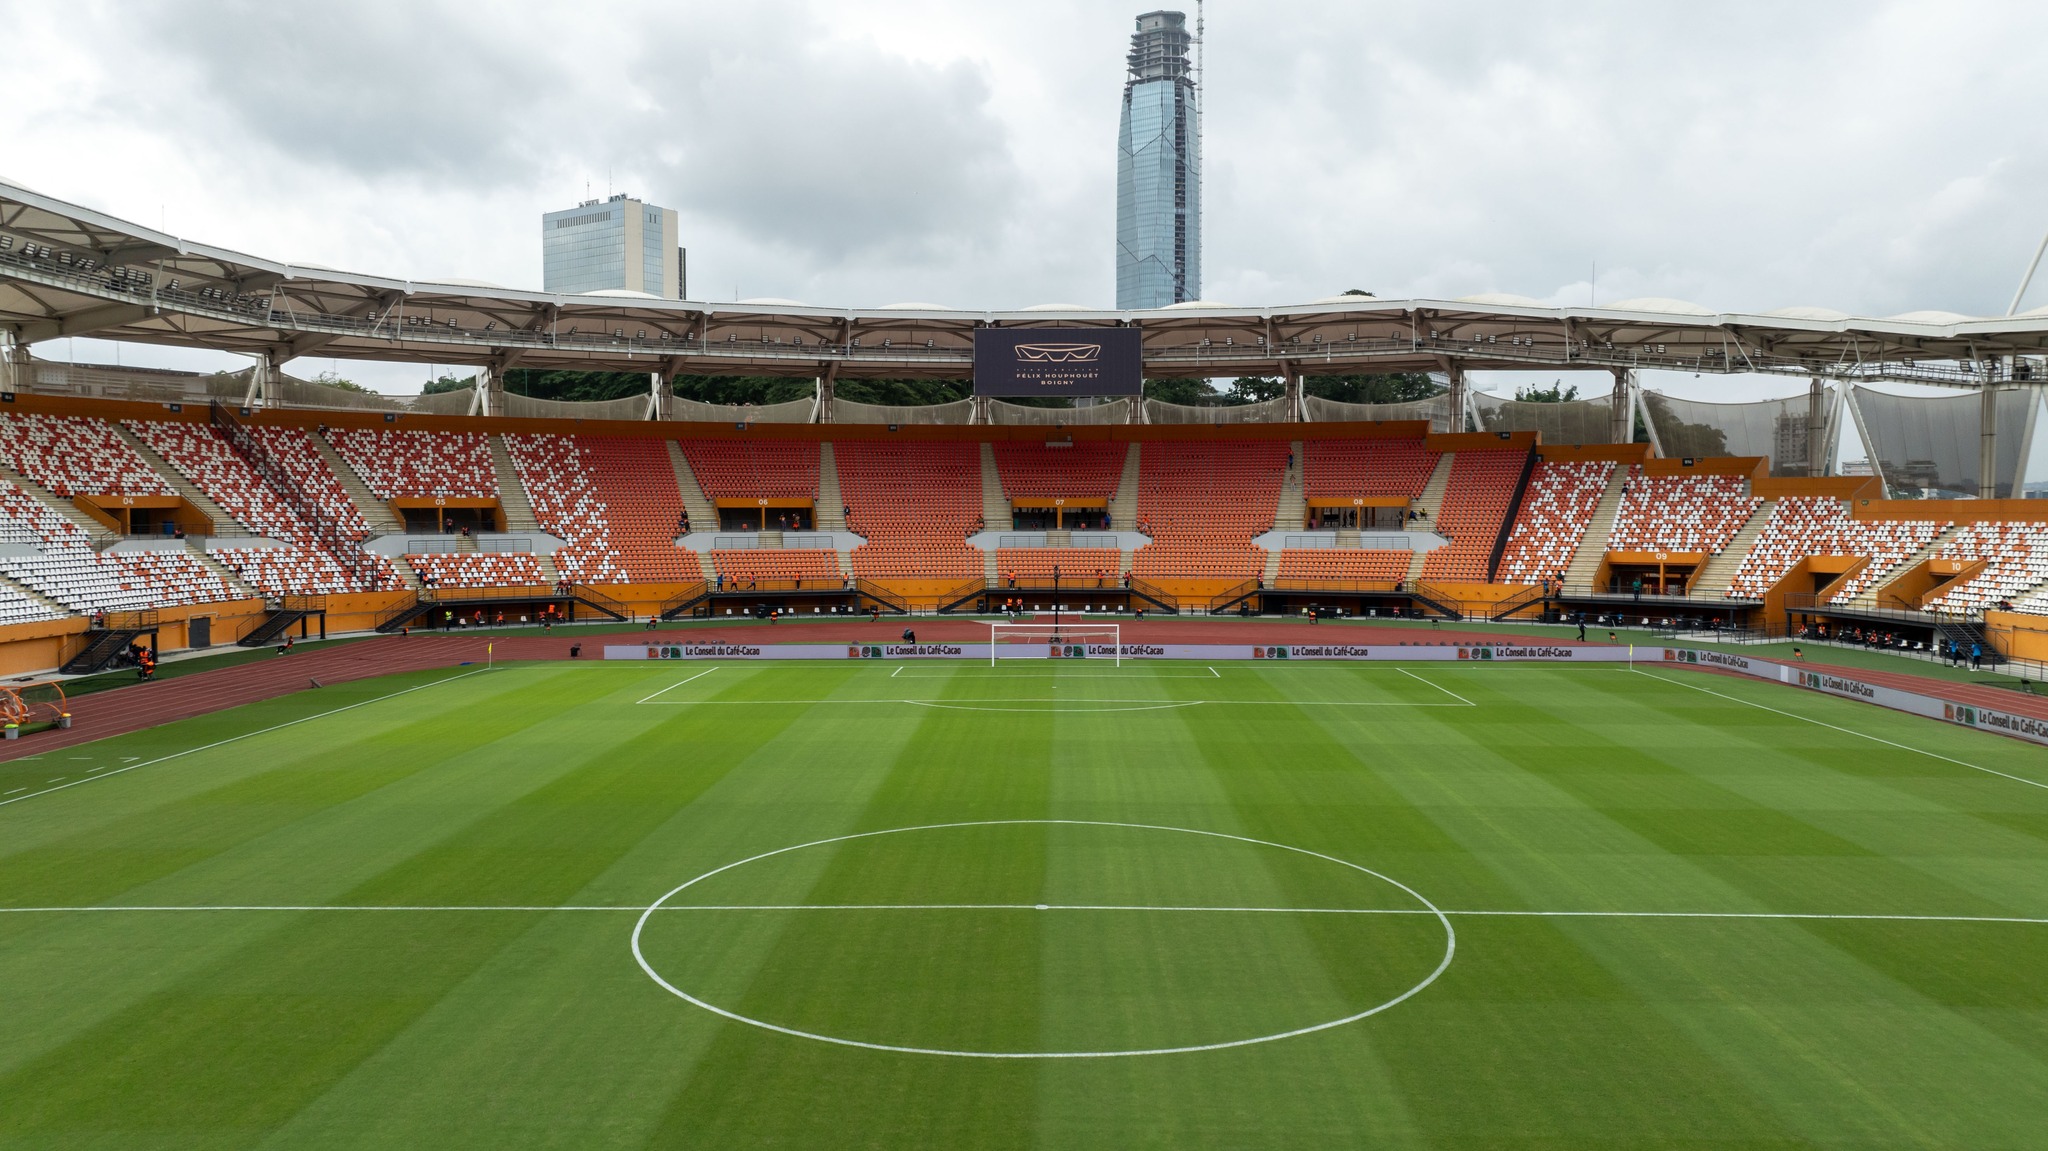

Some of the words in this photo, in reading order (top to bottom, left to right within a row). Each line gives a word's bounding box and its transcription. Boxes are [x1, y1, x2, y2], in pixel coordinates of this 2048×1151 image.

[1952, 562, 1961, 570] 10
[686, 646, 694, 656] Le
[694, 646, 716, 656] Conseil
[718, 646, 725, 656] du
[726, 645, 760, 656] Café-Cacao
[886, 646, 894, 655] Le
[896, 646, 917, 655] Conseil
[918, 646, 926, 655] du
[927, 644, 962, 655] Café-Cacao
[1088, 645, 1096, 654] Le
[1098, 645, 1118, 654] Consei
[1120, 646, 1128, 654] du
[1130, 644, 1164, 655] Café-Cacao
[1292, 646, 1300, 656] Le
[1301, 646, 1324, 656] Conseil
[1324, 646, 1332, 656] du
[1334, 645, 1368, 656] Café-Cacao
[1496, 648, 1504, 656] Le
[1505, 648, 1527, 657] Conseil
[1528, 648, 1536, 657] du
[1538, 646, 1572, 657] Café-Cacao
[1700, 652, 1706, 661] Le
[1708, 652, 1722, 664] Conseil
[1722, 654, 1728, 664] du
[1822, 676, 1828, 687] Le
[1828, 676, 1844, 690] Conseil
[1844, 680, 1850, 692] du
[1978, 710, 1986, 724] Le
[1988, 712, 2010, 729] Conseil
[2011, 716, 2020, 731] du
